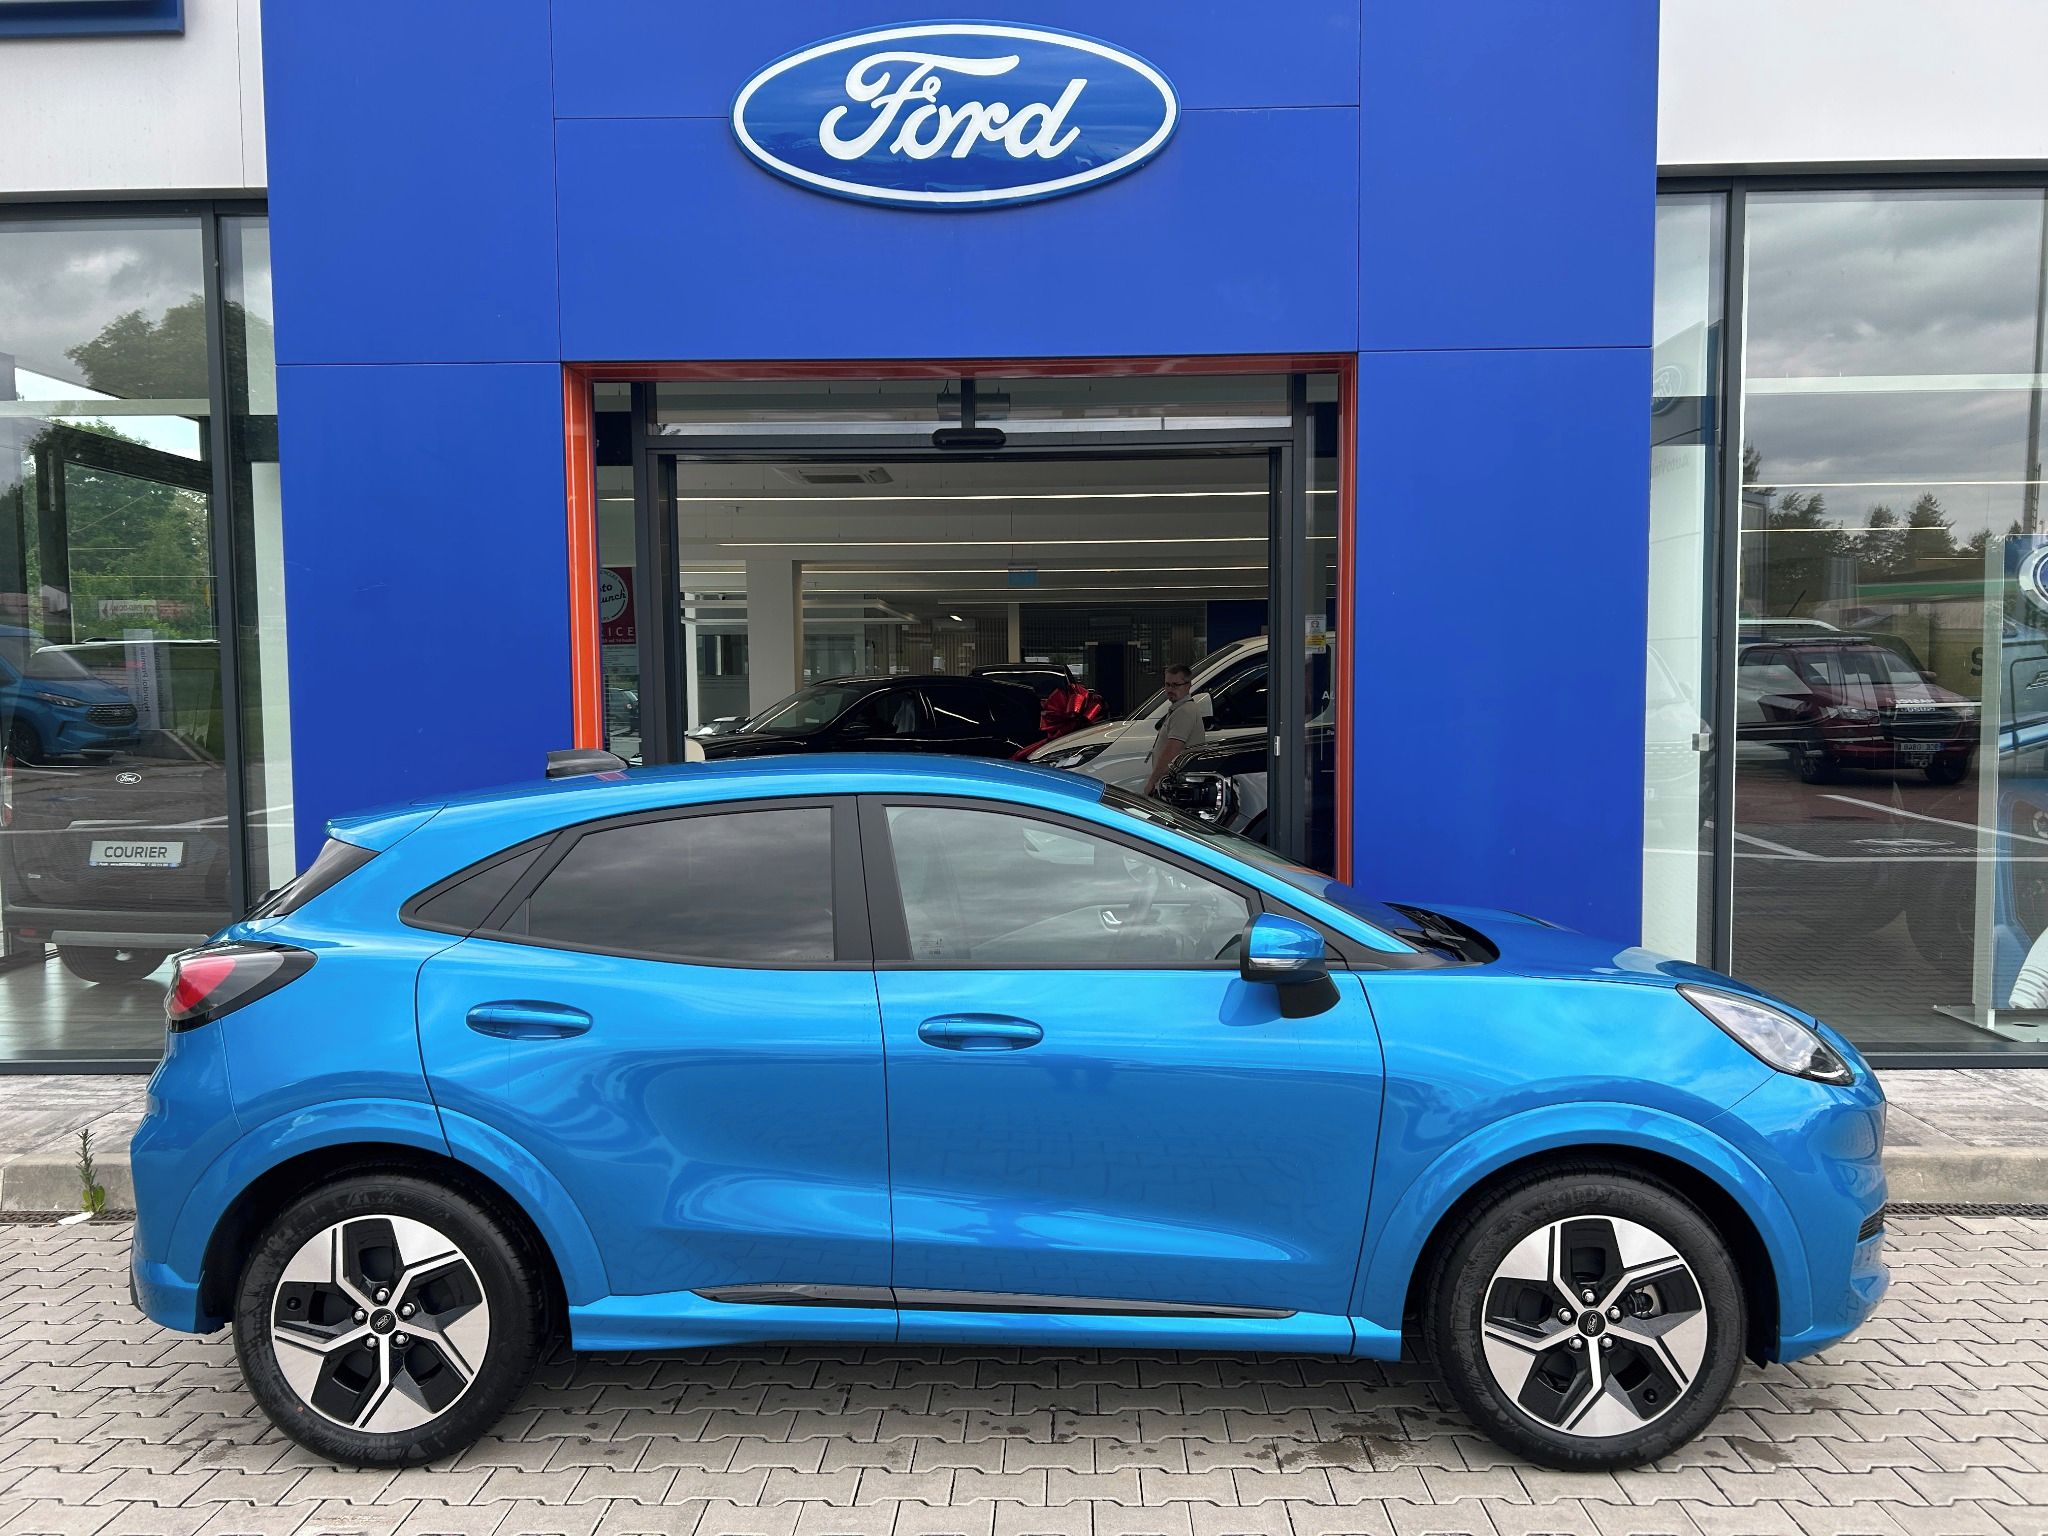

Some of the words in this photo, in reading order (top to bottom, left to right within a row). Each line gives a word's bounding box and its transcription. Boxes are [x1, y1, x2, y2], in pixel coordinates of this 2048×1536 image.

[818, 51, 1087, 160] Ford
[600, 588, 627, 603] unch
[608, 626, 635, 637] ICE
[104, 846, 168, 858] COURIER
